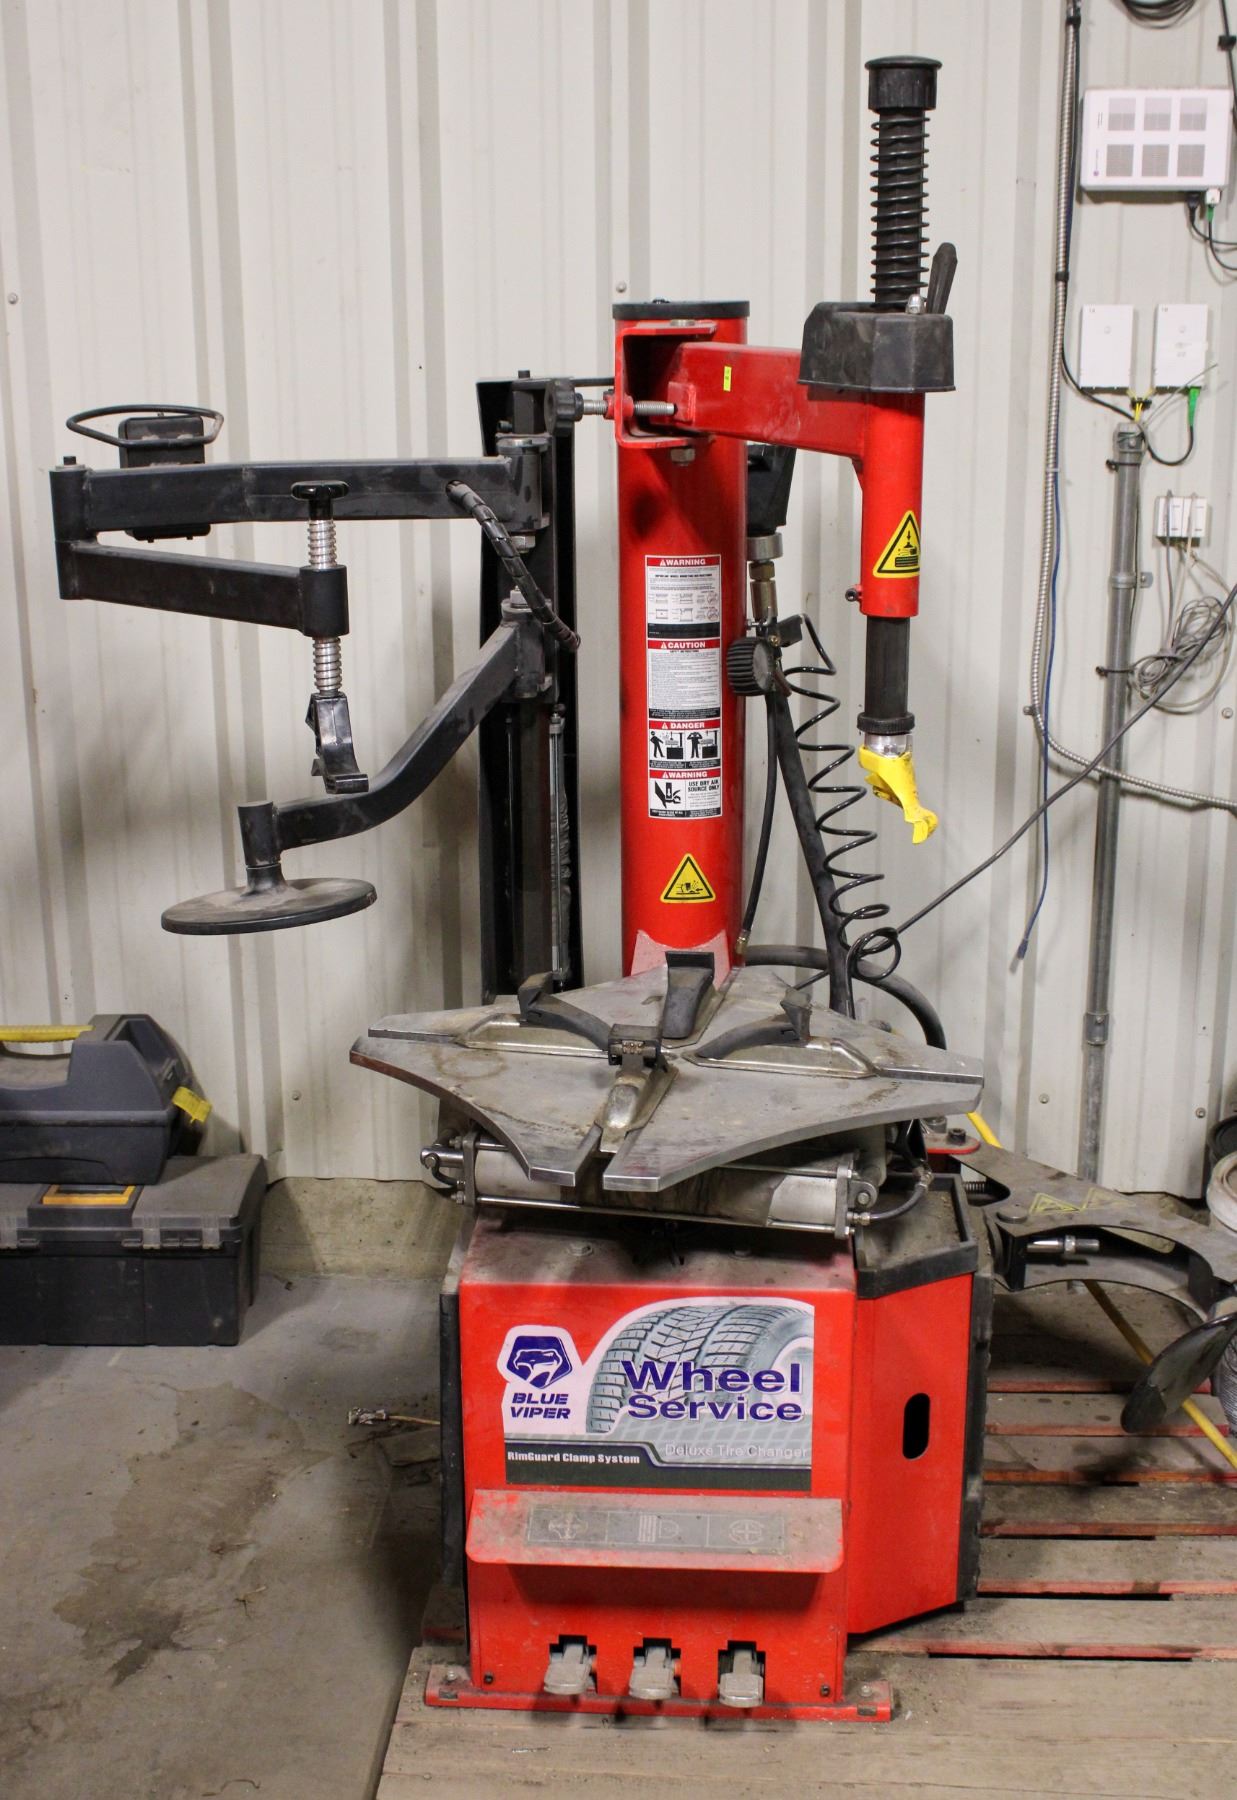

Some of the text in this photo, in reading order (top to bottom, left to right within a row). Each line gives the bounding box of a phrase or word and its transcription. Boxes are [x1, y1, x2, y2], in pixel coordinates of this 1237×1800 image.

[668, 641, 706, 649] CAUTION
[669, 771, 708, 779] WARNING
[620, 1360, 802, 1393] Wheel
[511, 1392, 569, 1405] BLUE
[510, 1406, 571, 1420] VIPER
[627, 1394, 803, 1422] Service
[507, 1451, 640, 1465] RimGuard Clamp System
[665, 1443, 807, 1460] Deluxe Tire Changer
